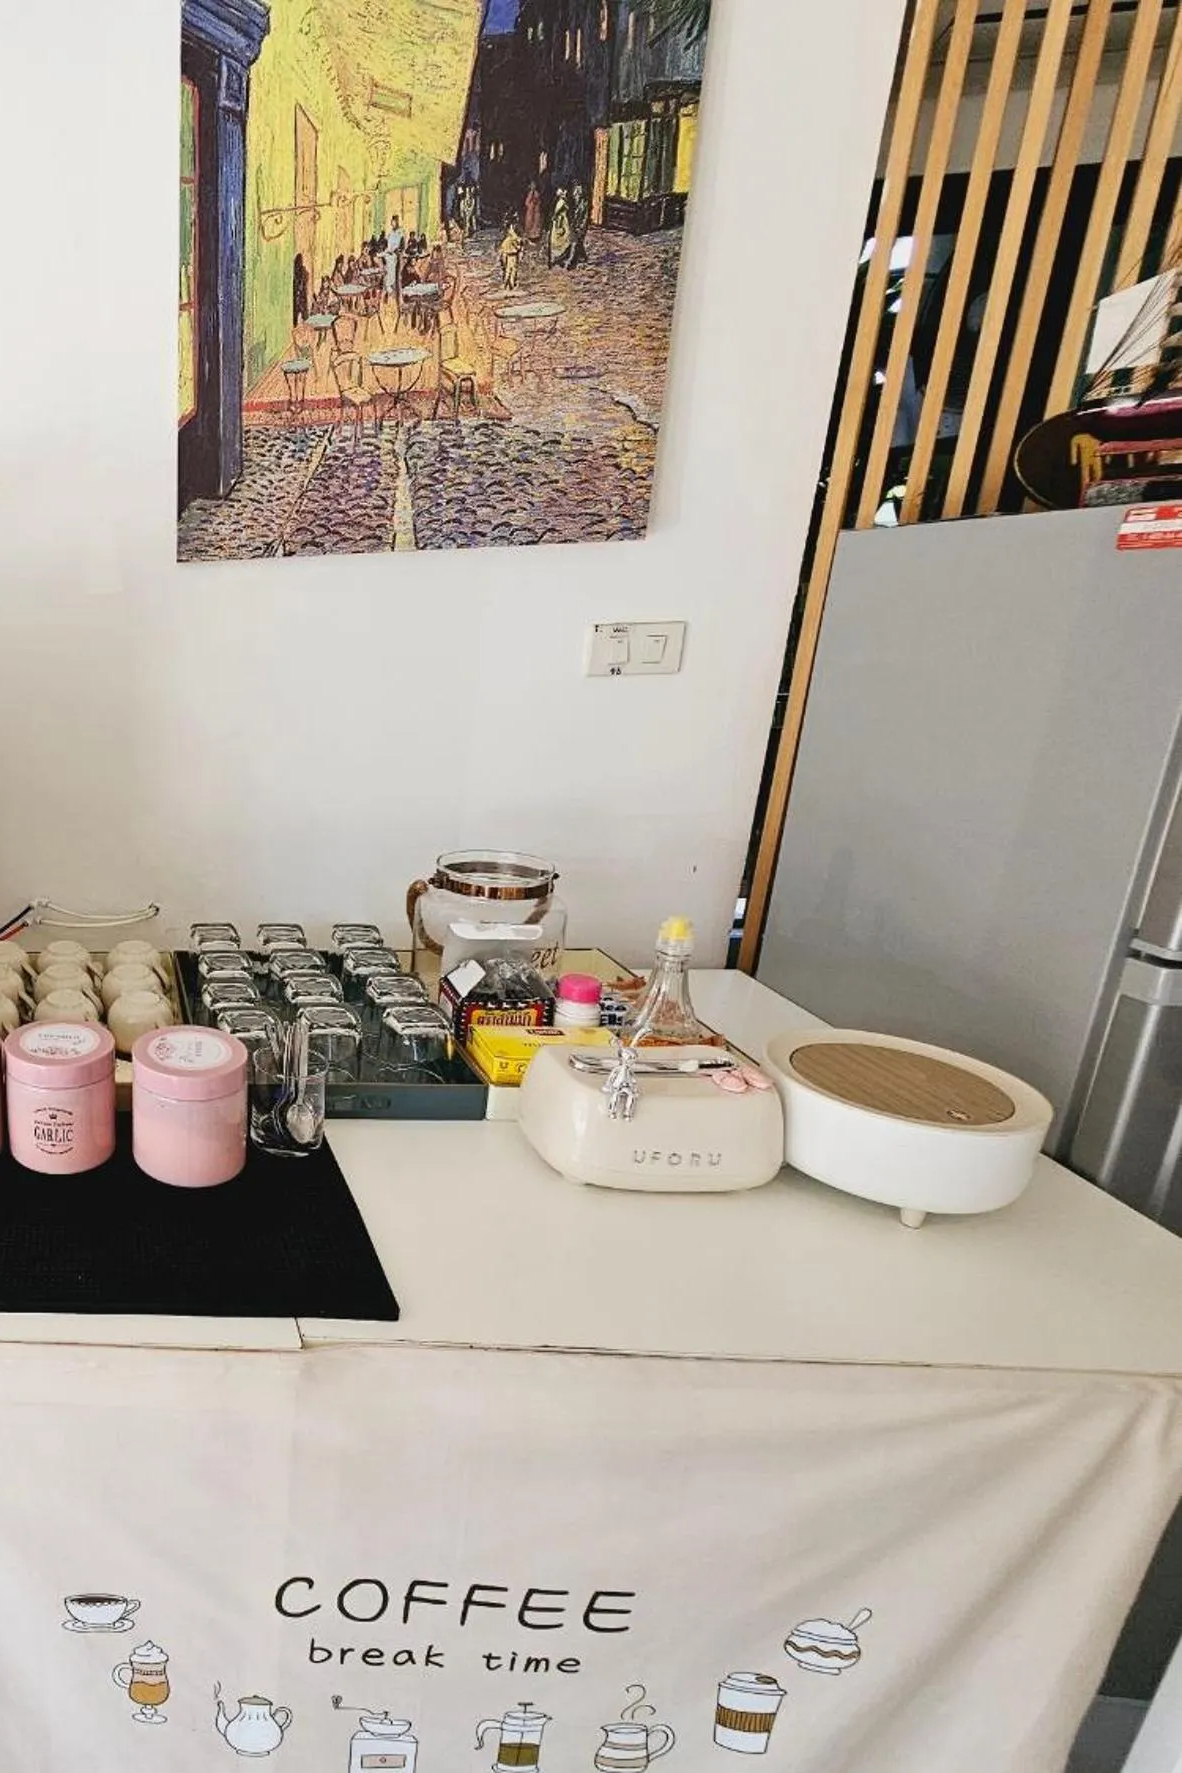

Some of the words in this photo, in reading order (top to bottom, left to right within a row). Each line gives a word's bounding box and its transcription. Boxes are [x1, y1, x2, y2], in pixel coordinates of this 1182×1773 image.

[530, 941, 559, 970] eet
[33, 1125, 74, 1143] GARLIC
[633, 1149, 723, 1168] UFORU
[275, 1576, 636, 1633] COFFEE
[308, 1638, 445, 1668] break
[482, 1651, 581, 1674] time
